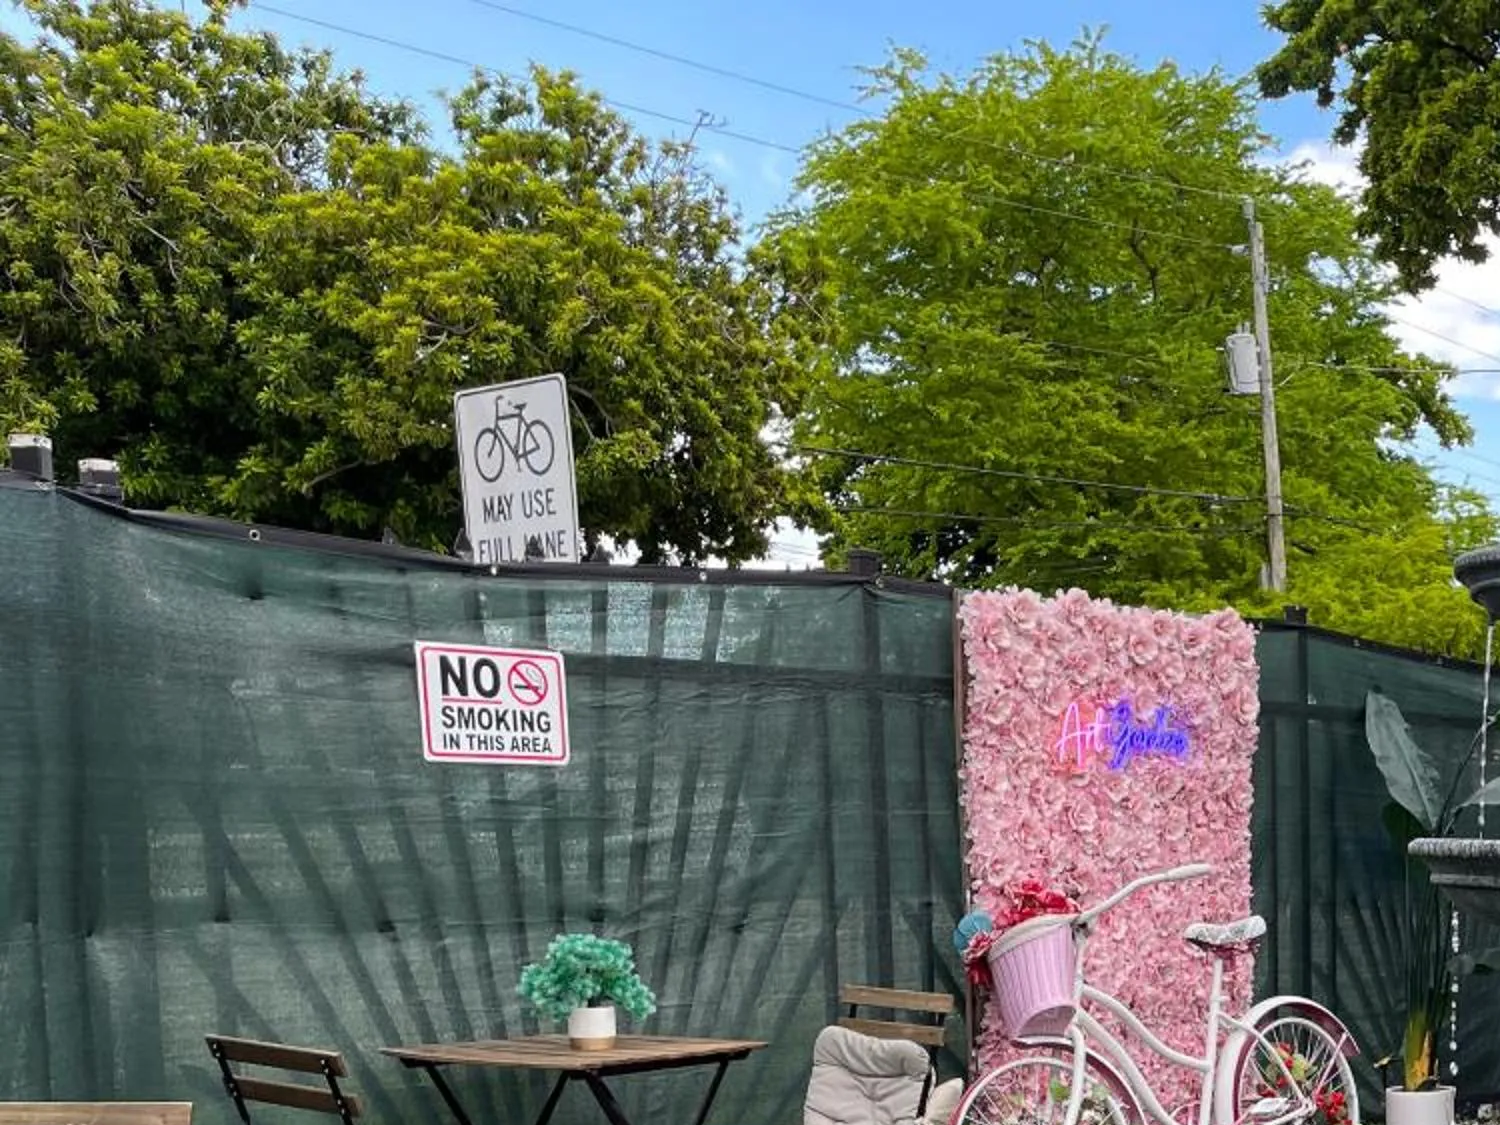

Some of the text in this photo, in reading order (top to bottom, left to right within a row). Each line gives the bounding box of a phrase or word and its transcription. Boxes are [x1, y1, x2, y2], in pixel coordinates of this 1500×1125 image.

[482, 487, 557, 524] MAY USE
[478, 535, 515, 563] FULL
[439, 654, 501, 698] NO
[441, 705, 551, 733] SMOKING
[1055, 703, 1110, 767] Art
[443, 733, 553, 753] IN THIS AREA
